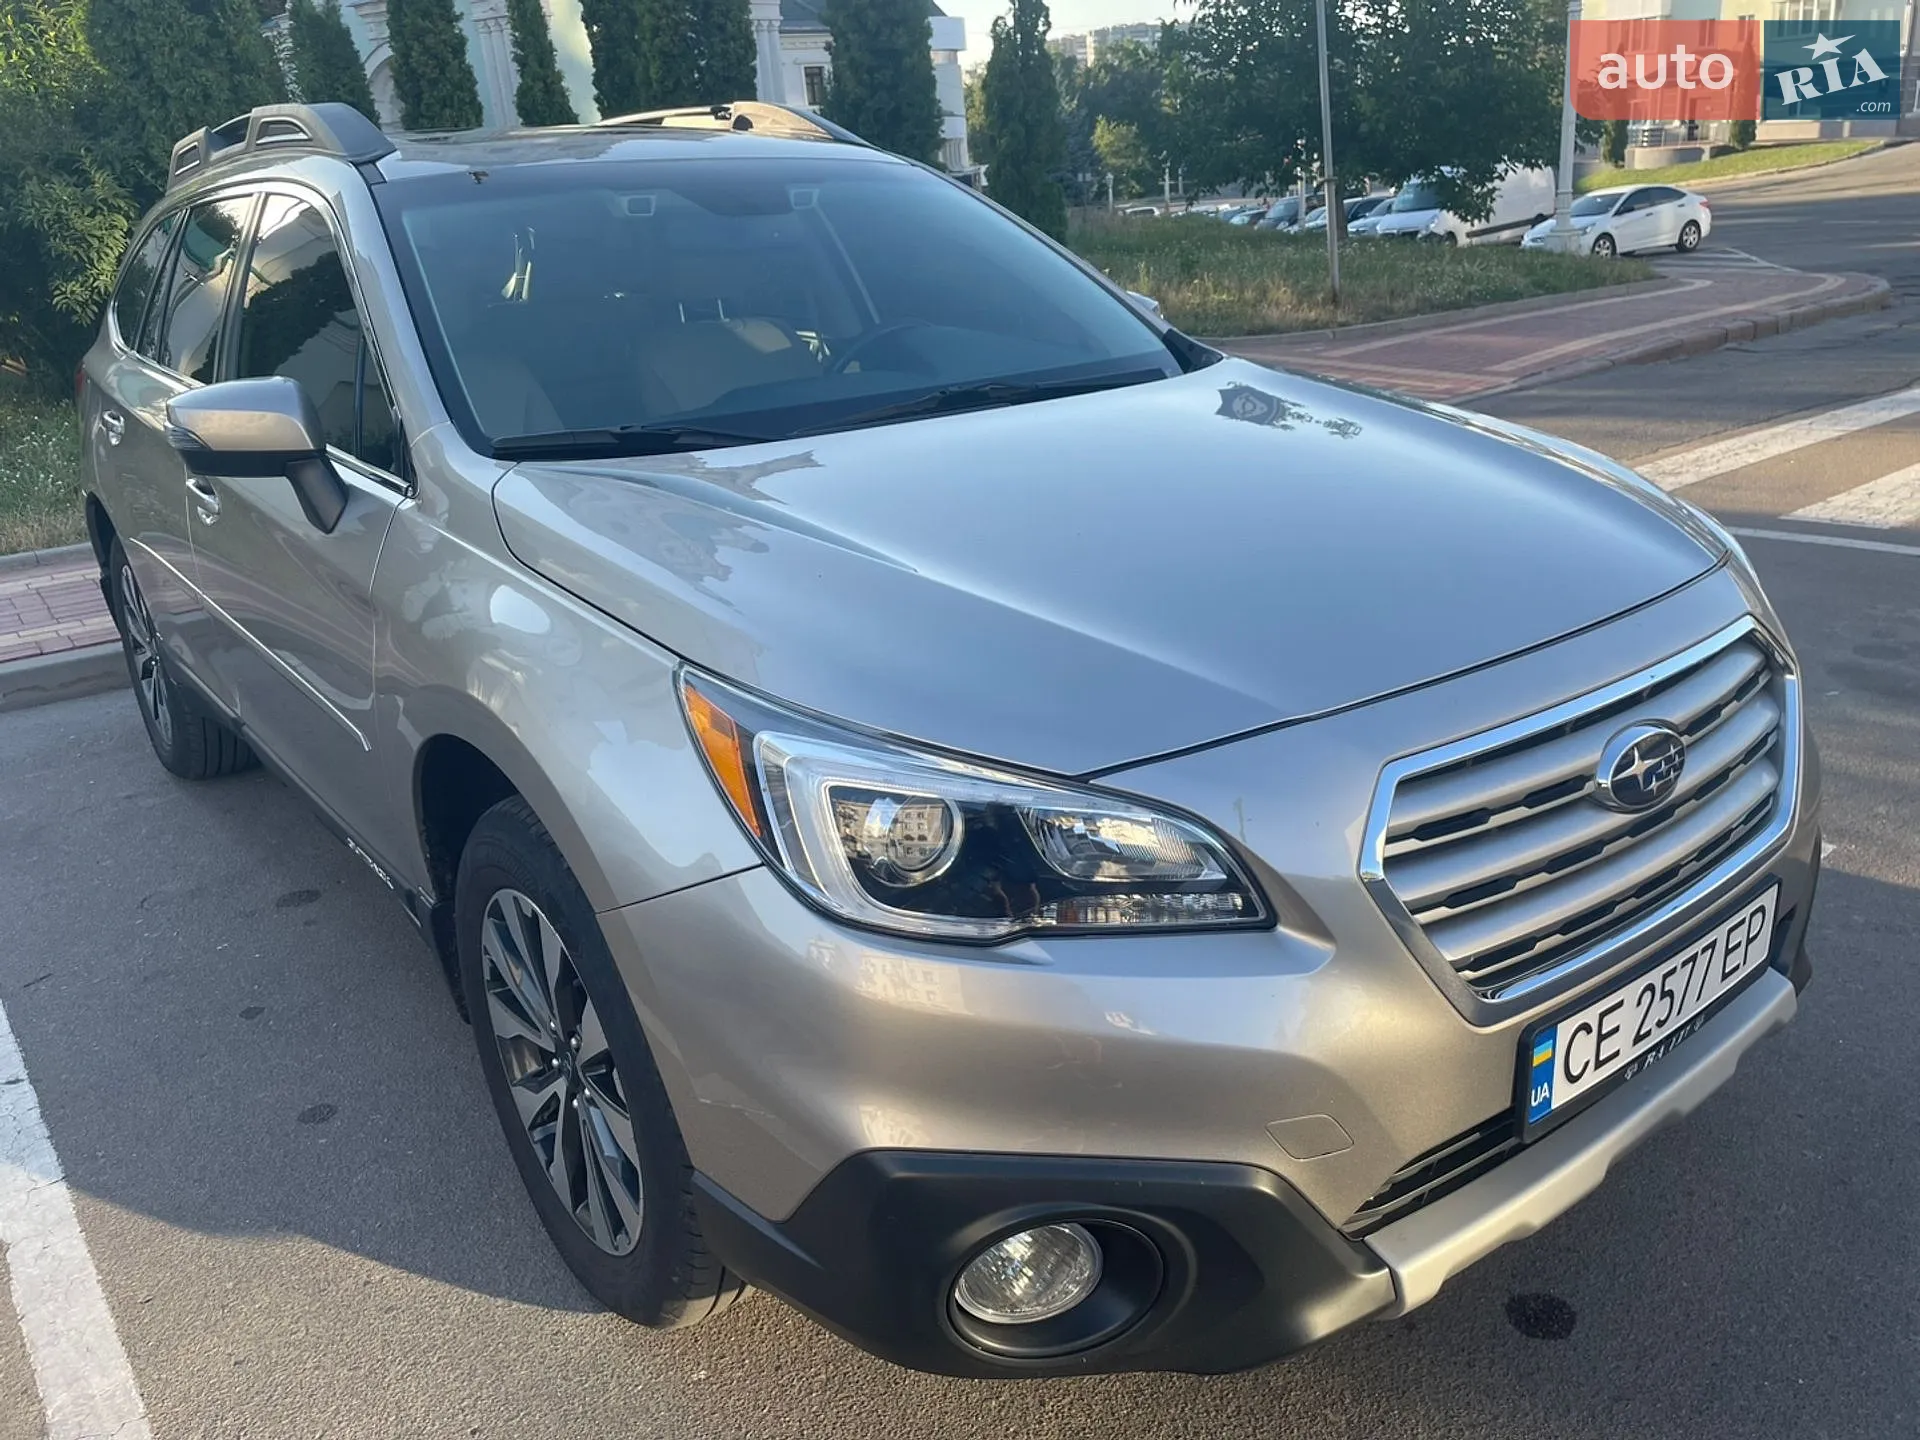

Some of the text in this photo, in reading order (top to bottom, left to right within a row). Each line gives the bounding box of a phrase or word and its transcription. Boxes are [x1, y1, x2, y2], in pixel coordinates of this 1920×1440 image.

[1563, 999, 1625, 1084] CE
[1632, 938, 1717, 1047] 2577
[1720, 904, 1767, 982] EP
[1531, 1082, 1550, 1106] UA
